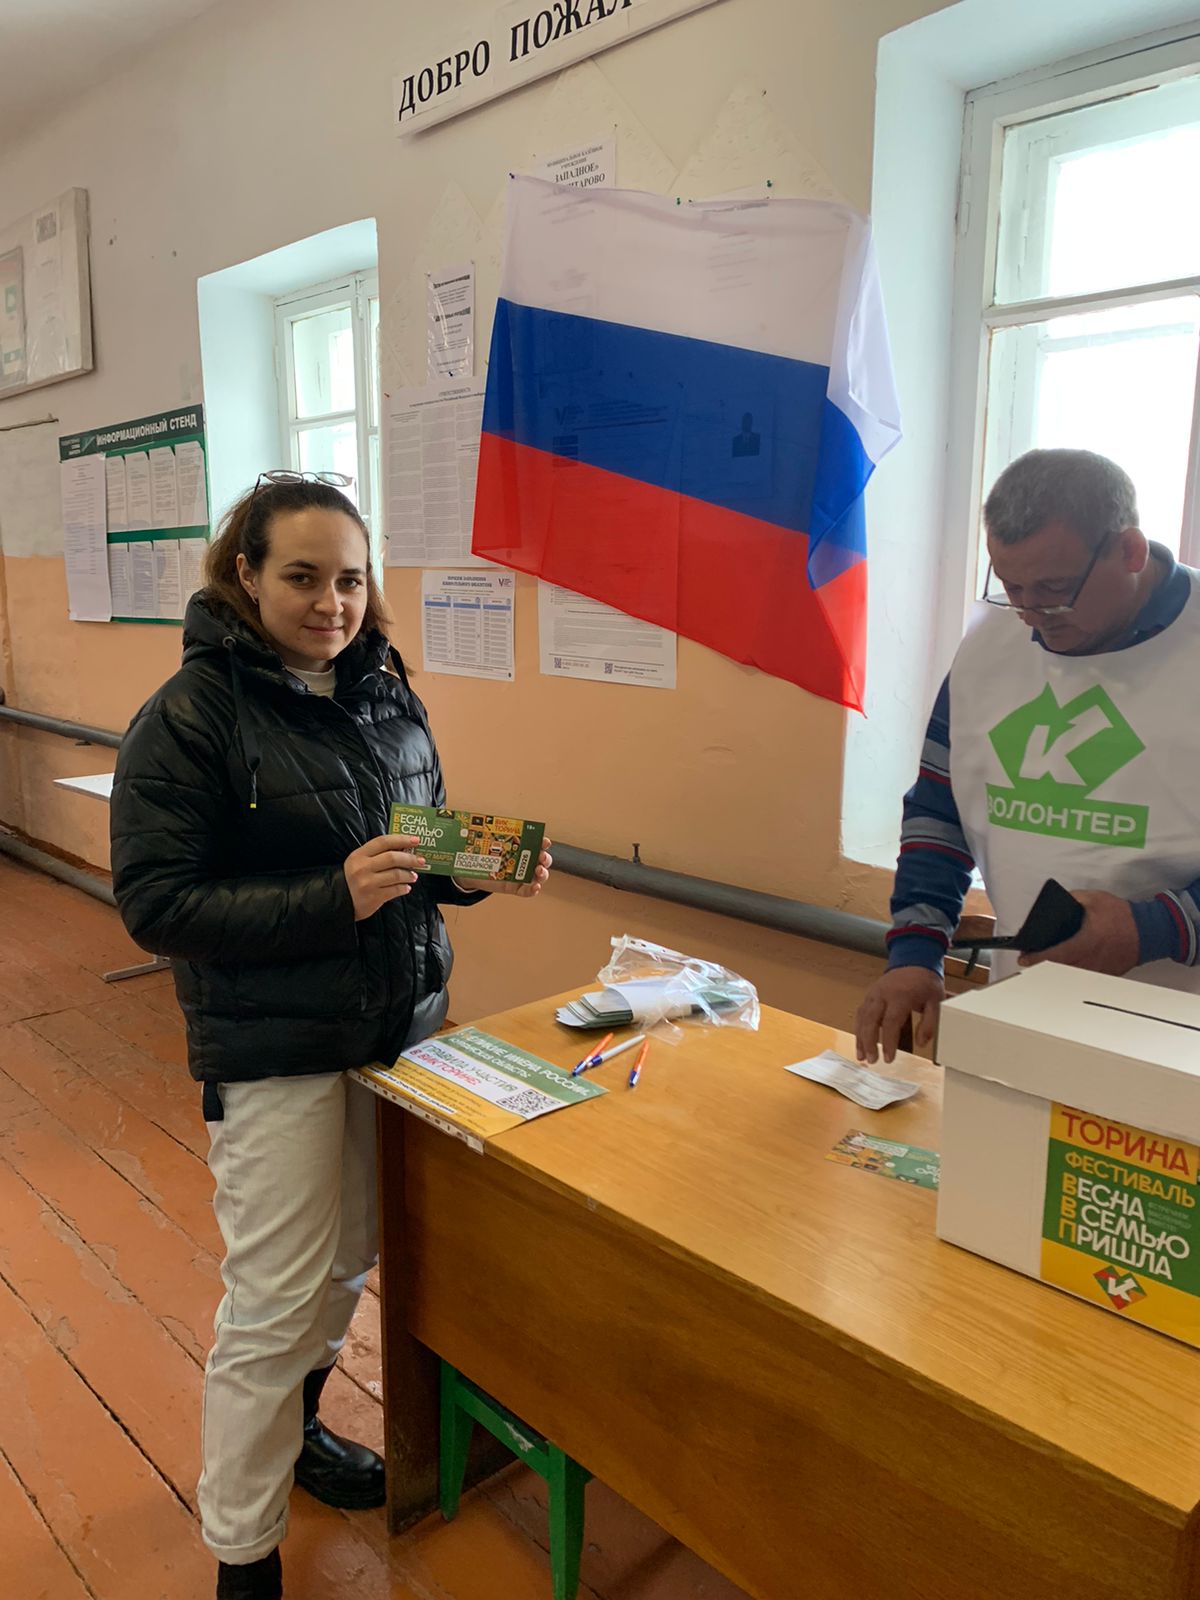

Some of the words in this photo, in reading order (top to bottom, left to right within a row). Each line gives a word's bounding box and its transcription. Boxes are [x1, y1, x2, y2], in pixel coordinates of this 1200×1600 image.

[399, 41, 491, 121] ДОБРО
[96, 418, 168, 446] ИНФОРМАЦИОННЫЙ
[169, 413, 198, 430] СТЕНД
[393, 822, 400, 833] В
[401, 824, 444, 838] СЕМЬЮ
[394, 813, 427, 826] ВЕСНА
[1061, 1111, 1190, 1176] ТОРИНА
[1062, 1172, 1145, 1221] ВЕСНА
[1065, 1151, 1196, 1209] ФЕСТИВАЛЬ
[1059, 1218, 1173, 1281] ПРИШЛА
[1060, 1195, 1078, 1219] В
[1081, 1205, 1191, 1259] СЕМЬЮ
